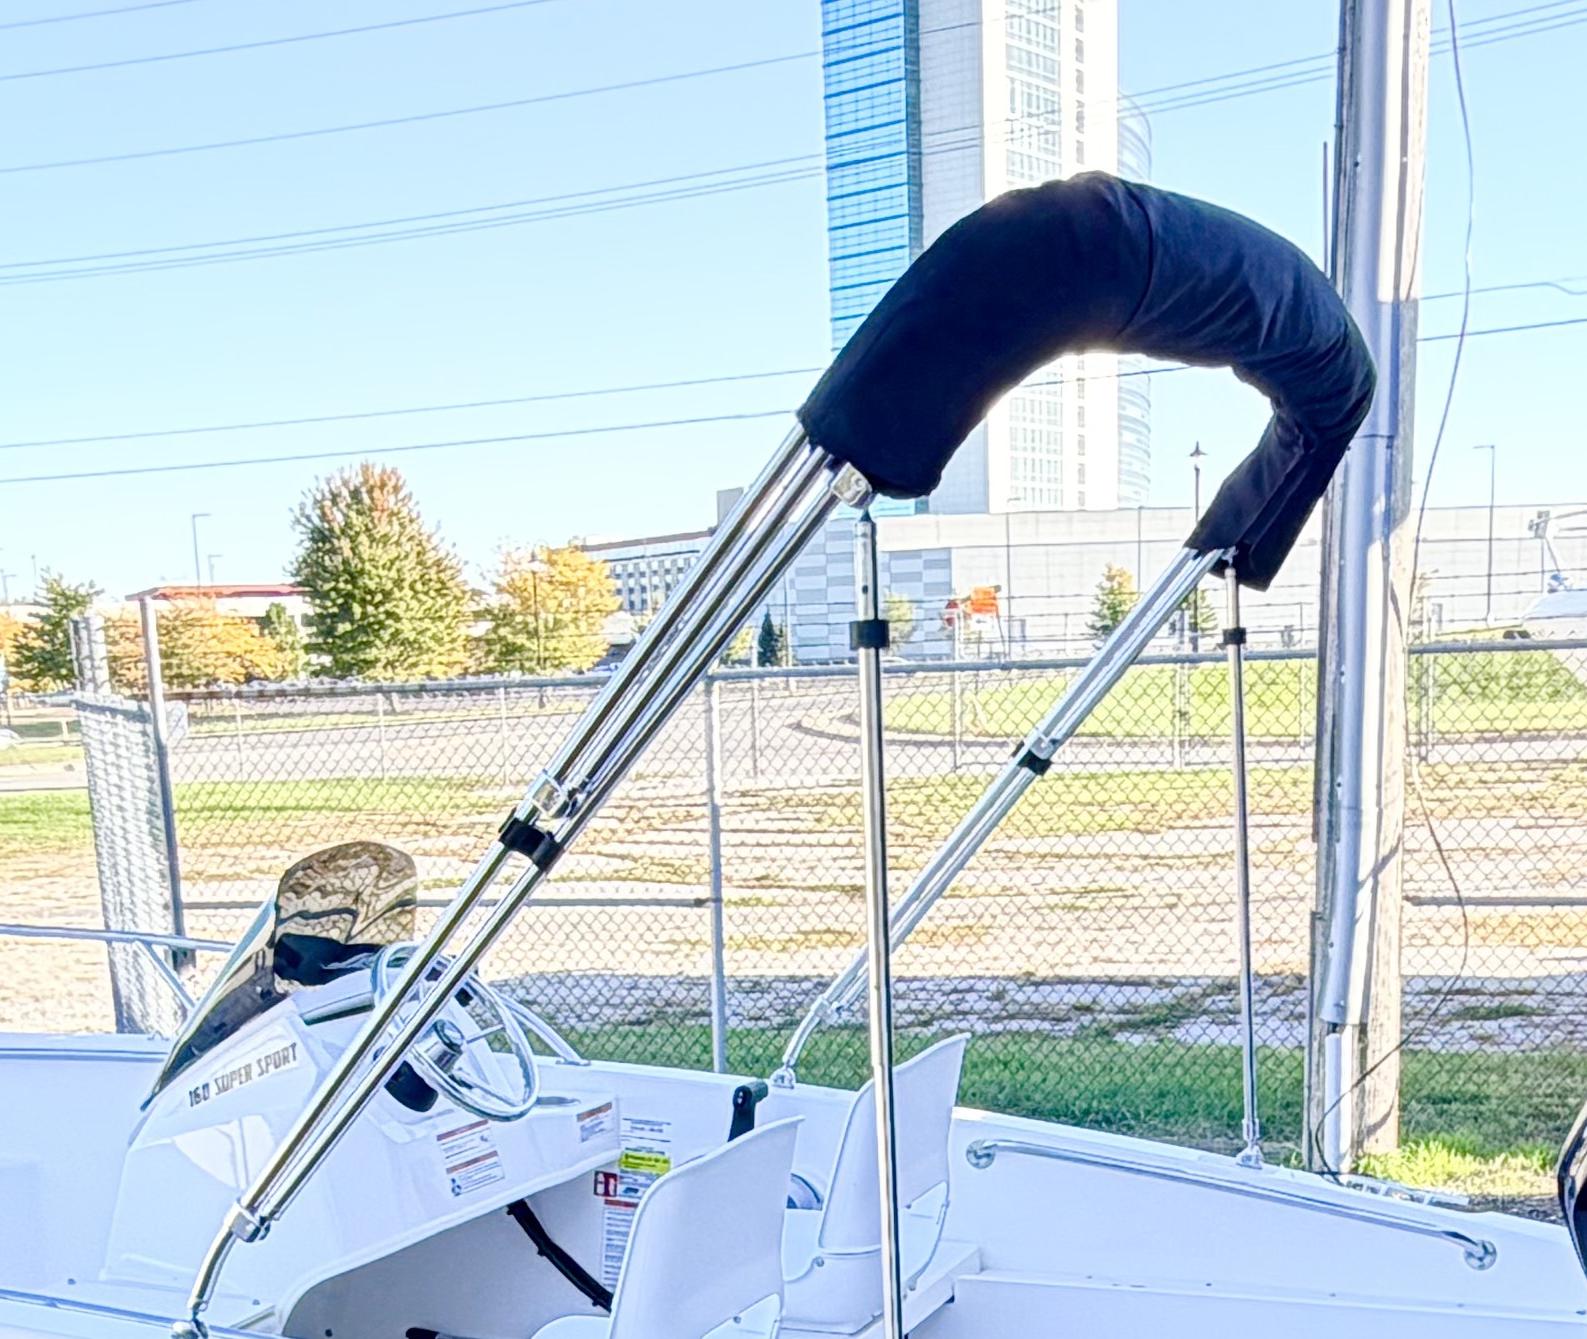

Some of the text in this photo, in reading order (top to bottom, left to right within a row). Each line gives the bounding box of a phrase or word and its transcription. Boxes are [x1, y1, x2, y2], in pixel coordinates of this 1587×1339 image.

[189, 1042, 298, 1107] 160 SUPER SPORT
